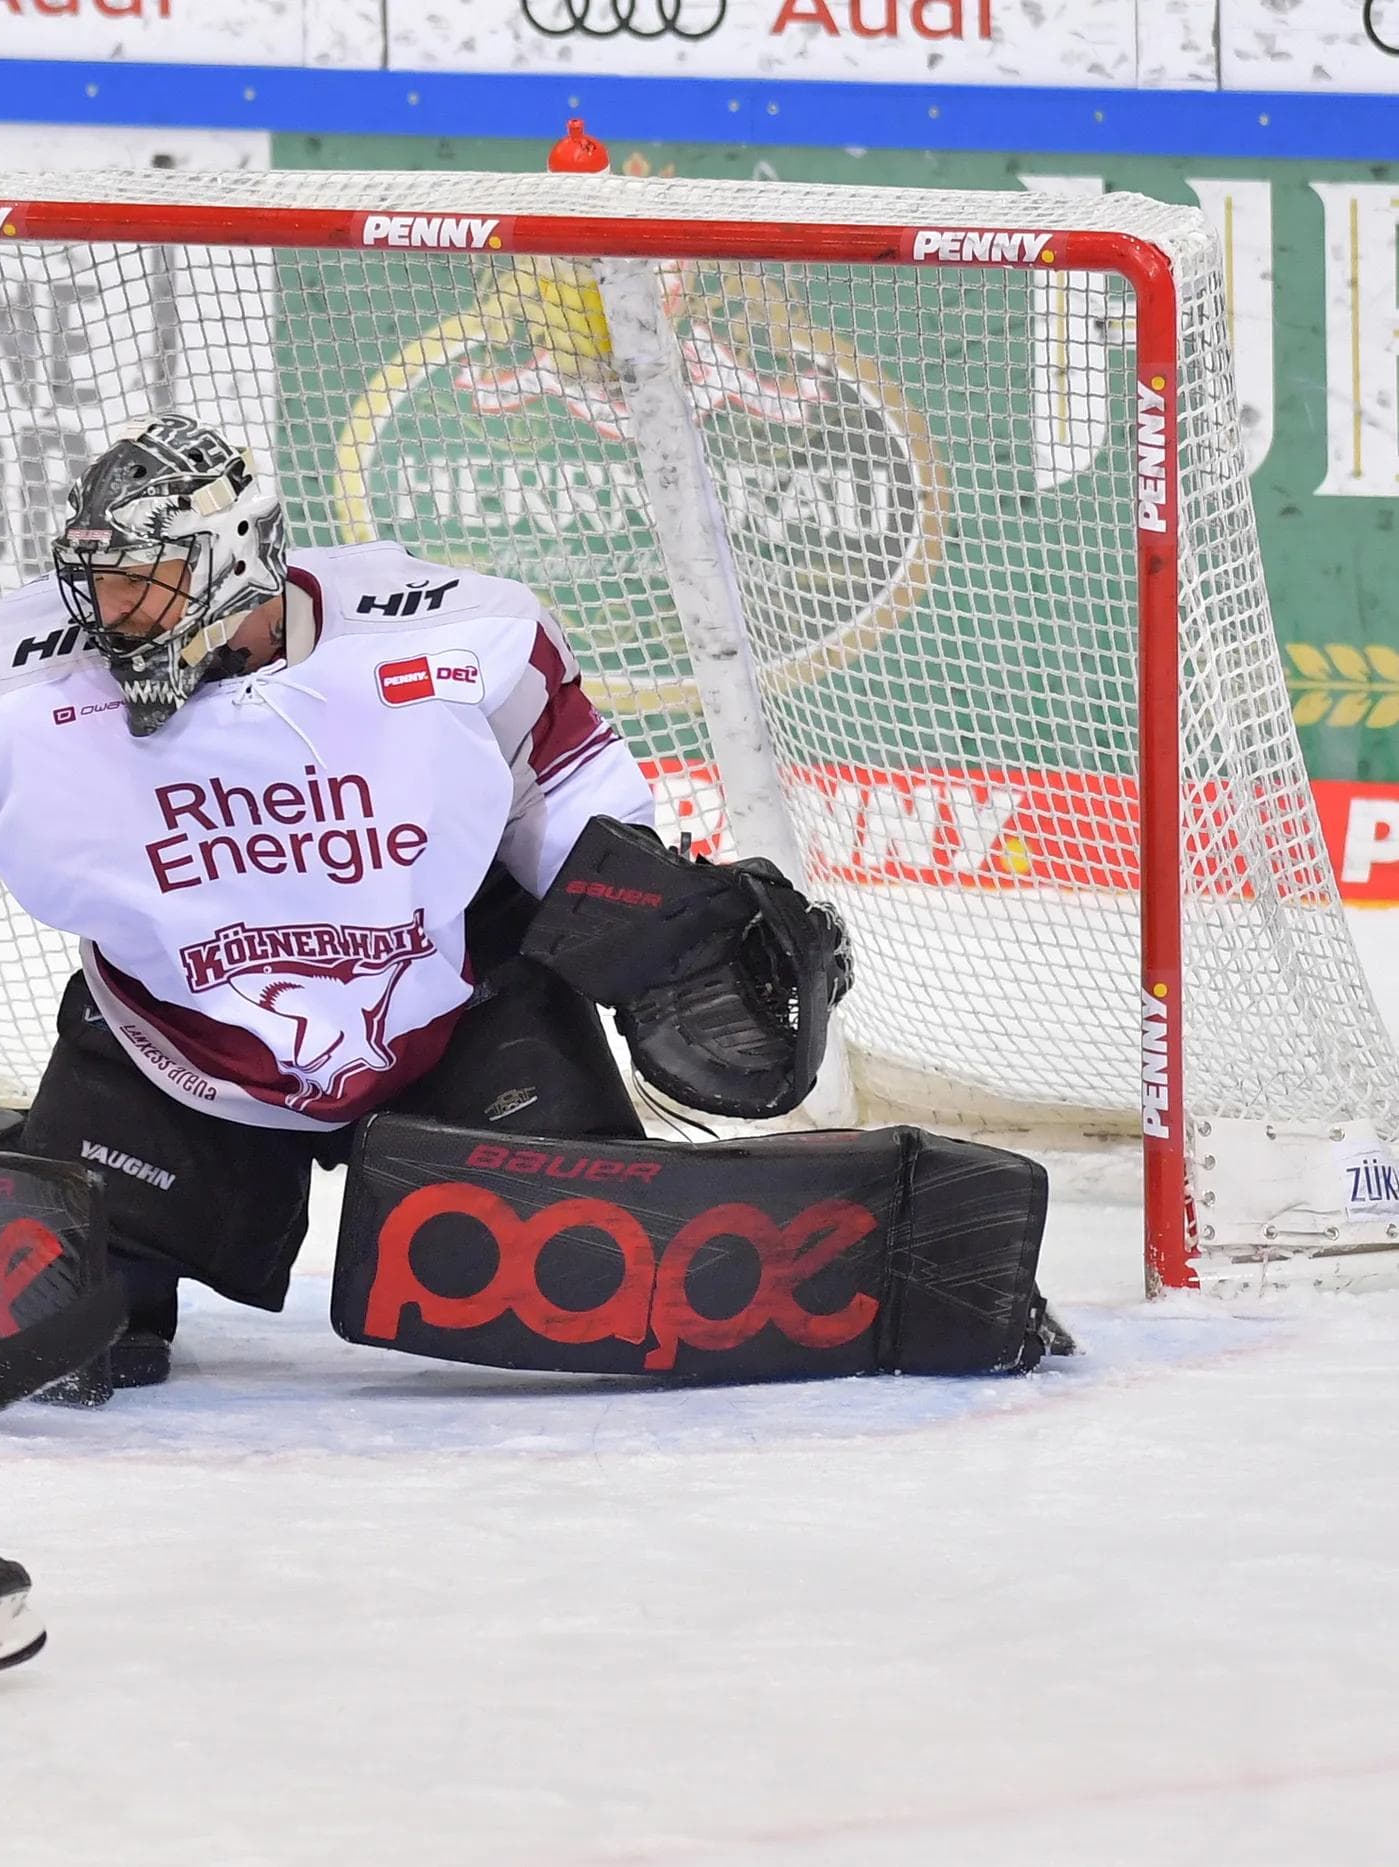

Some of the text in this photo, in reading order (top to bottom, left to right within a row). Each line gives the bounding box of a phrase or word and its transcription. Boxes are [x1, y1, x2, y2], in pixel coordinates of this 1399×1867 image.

[356, 578, 461, 617] HIT
[11, 618, 100, 668] HI
[154, 764, 374, 832] Rhein
[145, 822, 429, 895] Energie
[185, 925, 348, 990] KÖLNER
[166, 1064, 217, 1102] arena
[79, 1140, 176, 1191] VAUGHN
